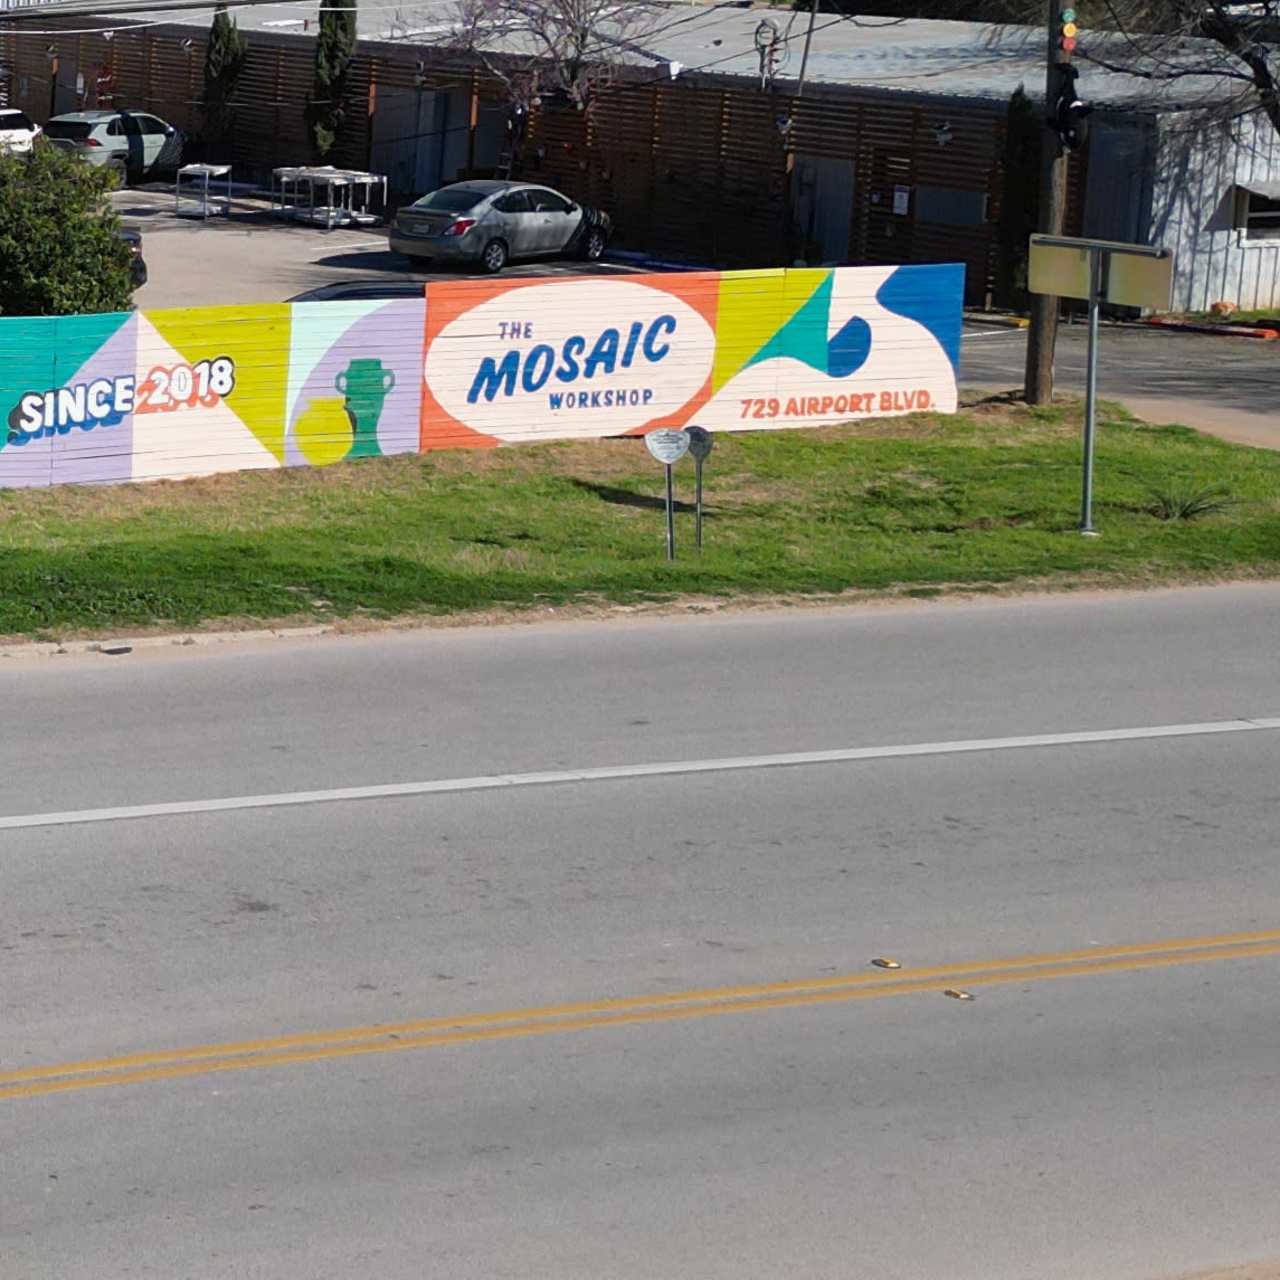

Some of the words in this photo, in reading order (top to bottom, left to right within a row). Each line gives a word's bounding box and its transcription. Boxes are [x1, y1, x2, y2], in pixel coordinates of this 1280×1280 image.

[498, 322, 534, 340] THE
[467, 314, 677, 404] MOSAIC
[19, 375, 135, 433] SINCE
[147, 357, 235, 405] 2018
[549, 388, 653, 410] WORKSHOP
[740, 398, 780, 419] 729
[783, 392, 876, 417] AIRPORT
[879, 389, 937, 412] BLVD.
